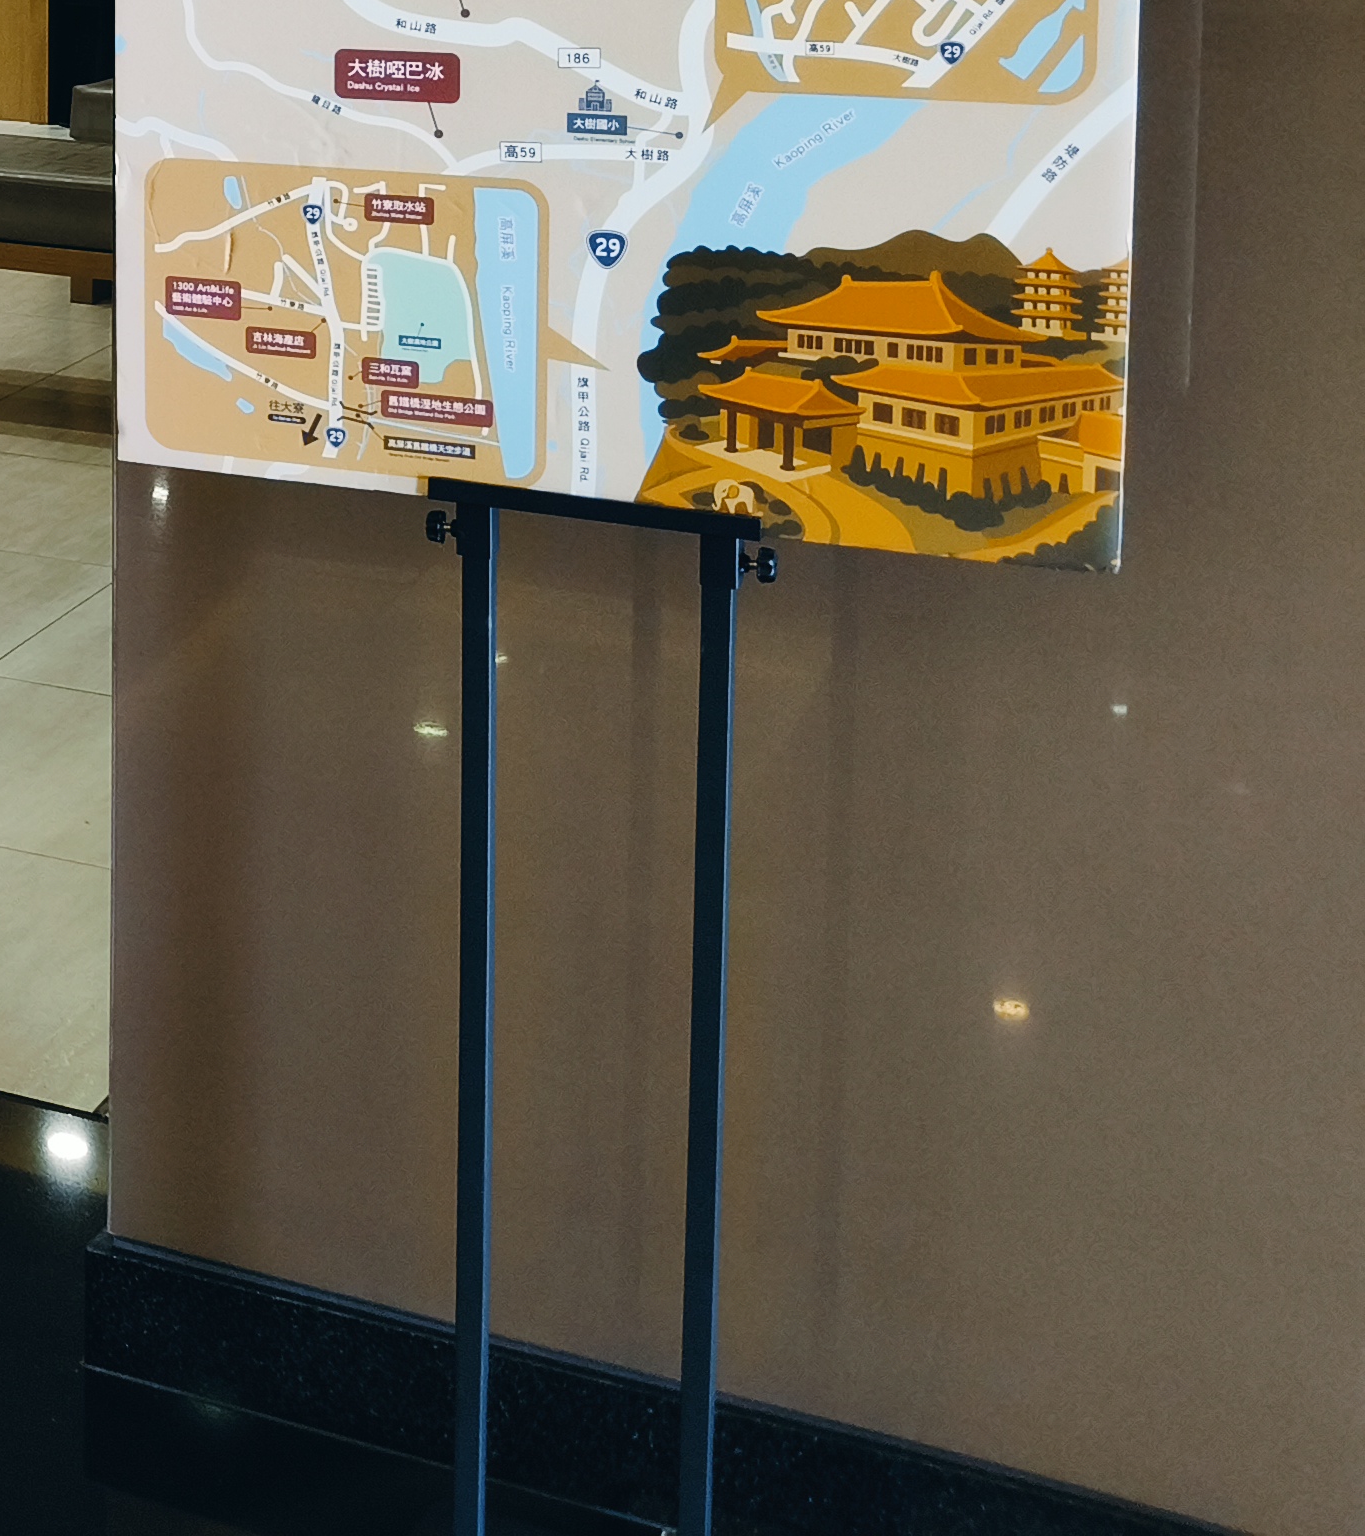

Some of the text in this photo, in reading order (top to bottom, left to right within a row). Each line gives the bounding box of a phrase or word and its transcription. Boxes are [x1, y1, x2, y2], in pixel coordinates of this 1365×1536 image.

[396, 18, 437, 35] 和山路
[567, 53, 590, 64] 186
[943, 45, 960, 58] 29
[347, 58, 445, 80] 大樹啞巴冰
[375, 82, 404, 92] Crystal
[407, 84, 420, 92] Ice
[634, 88, 678, 110] 和山路
[573, 118, 620, 131] 大樹國小
[774, 110, 854, 168] Kaoping River
[504, 145, 536, 159] 高59
[625, 148, 669, 162] 大樹路
[1040, 142, 1081, 184] 堤防路
[305, 207, 320, 219] 29
[595, 237, 621, 258] 29
[172, 282, 194, 291] 1300
[502, 286, 515, 372] Kaoping River
[578, 377, 590, 431] 旗甲公路
[329, 430, 343, 442] 29
